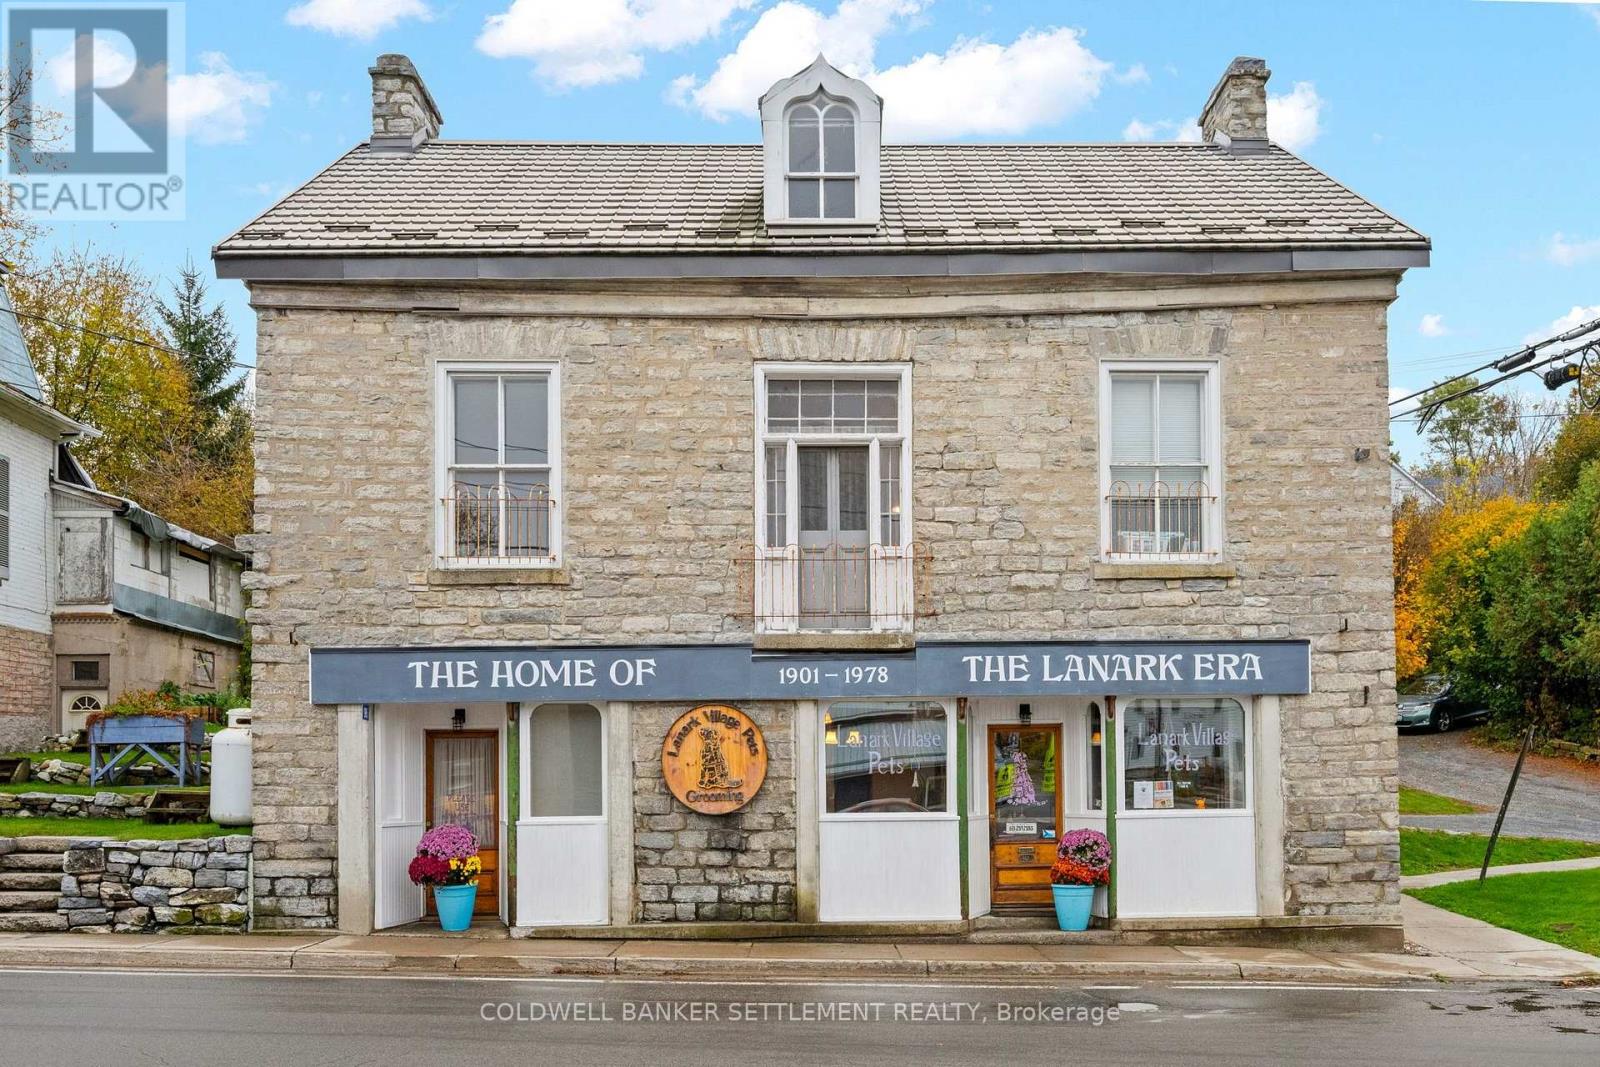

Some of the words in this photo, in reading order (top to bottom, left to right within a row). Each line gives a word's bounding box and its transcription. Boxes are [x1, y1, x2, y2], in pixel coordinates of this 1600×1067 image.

[408, 660, 479, 688] THE
[491, 659, 597, 688] HOME
[609, 658, 657, 686] OF
[779, 667, 819, 684] 1901
[845, 666, 889, 684] 1978
[962, 654, 1031, 682] THE
[1042, 654, 1184, 682] LANARK
[1193, 653, 1263, 680] ERA
[667, 716, 701, 757] Lanark
[703, 710, 740, 729] Village
[742, 727, 759, 756] Pets
[837, 724, 890, 748] Lanark
[892, 723, 941, 748] Village
[1137, 722, 1191, 746] Lanark
[867, 751, 904, 774] Pets
[1164, 748, 1200, 771] Pets
[686, 790, 744, 804] Grooming
